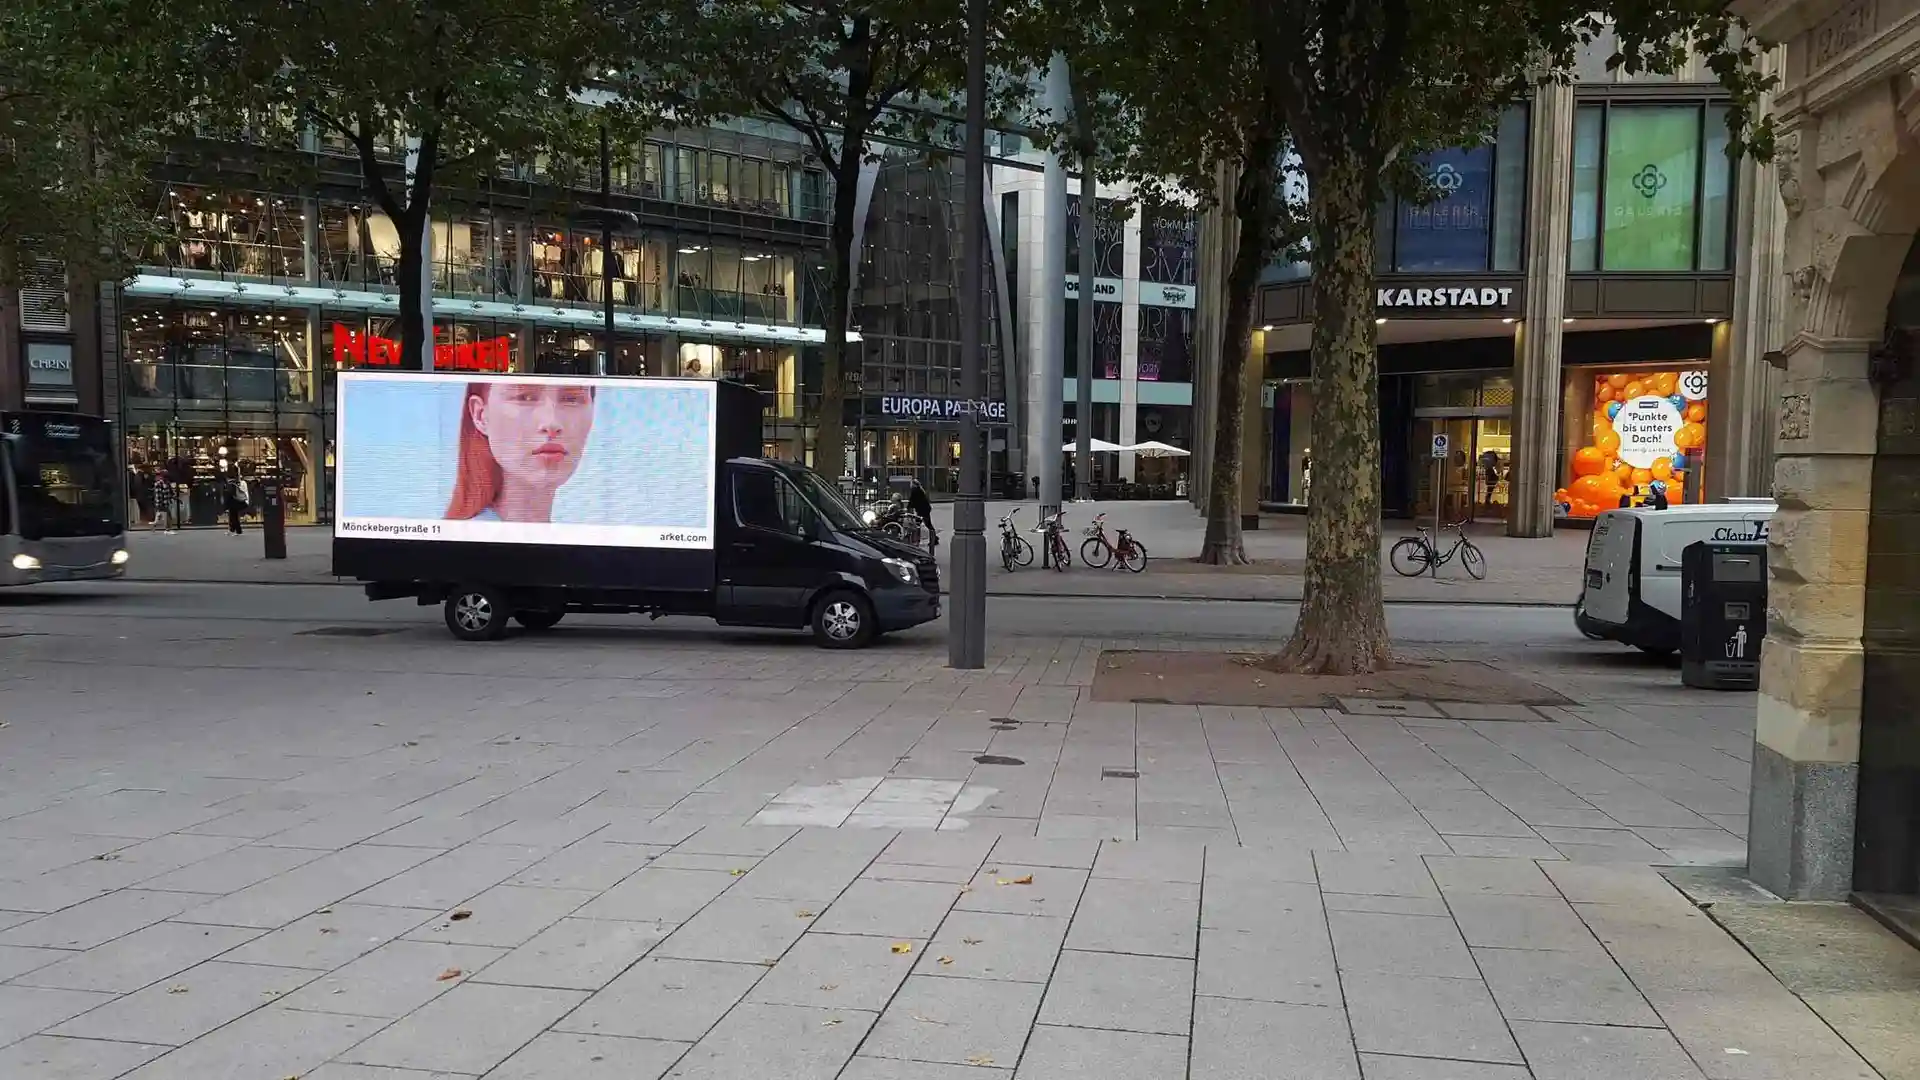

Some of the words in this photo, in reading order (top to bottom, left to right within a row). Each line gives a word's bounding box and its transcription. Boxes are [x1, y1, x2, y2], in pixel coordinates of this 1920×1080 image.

[1376, 287, 1513, 307] KARSTADT
[881, 397, 942, 416] EUROPA
[945, 400, 1006, 418] PAAGE
[1622, 423, 1638, 432] bis
[1640, 424, 1673, 432] unters
[1632, 434, 1662, 443] Dach!
[342, 521, 428, 535] Mönckebergstraße
[432, 525, 441, 533] 11
[660, 532, 707, 542] arket.com
